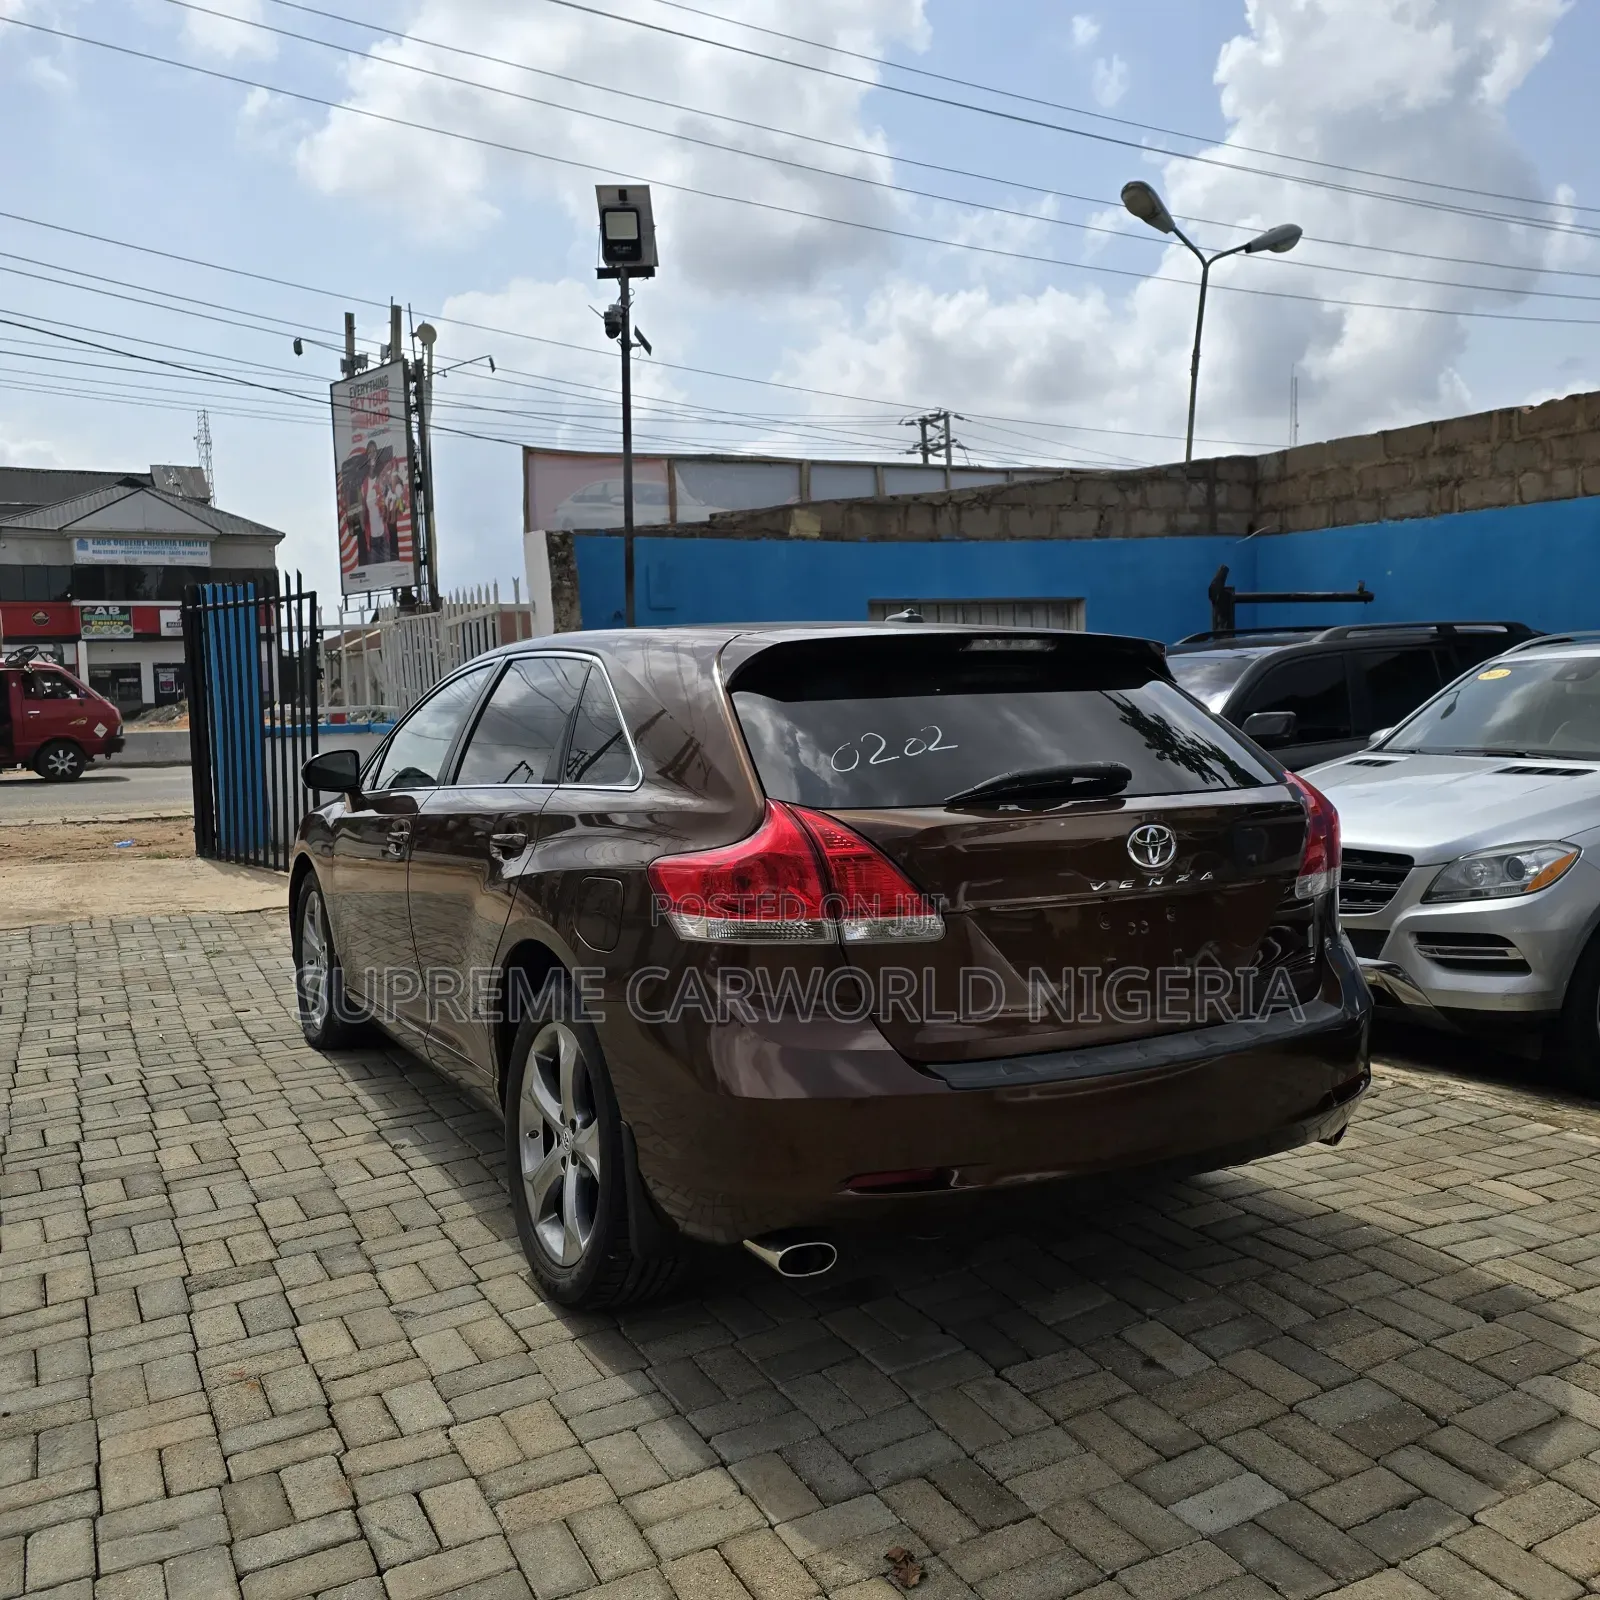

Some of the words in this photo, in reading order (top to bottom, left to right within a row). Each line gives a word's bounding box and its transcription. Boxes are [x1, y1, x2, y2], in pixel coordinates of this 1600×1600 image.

[349, 375, 389, 398] EVERYTHING
[367, 388, 389, 409] YOUR
[366, 407, 391, 428] HAND
[179, 540, 208, 548] LIMITED
[831, 725, 958, 772] 0202
[1089, 871, 1214, 891] VENZA
